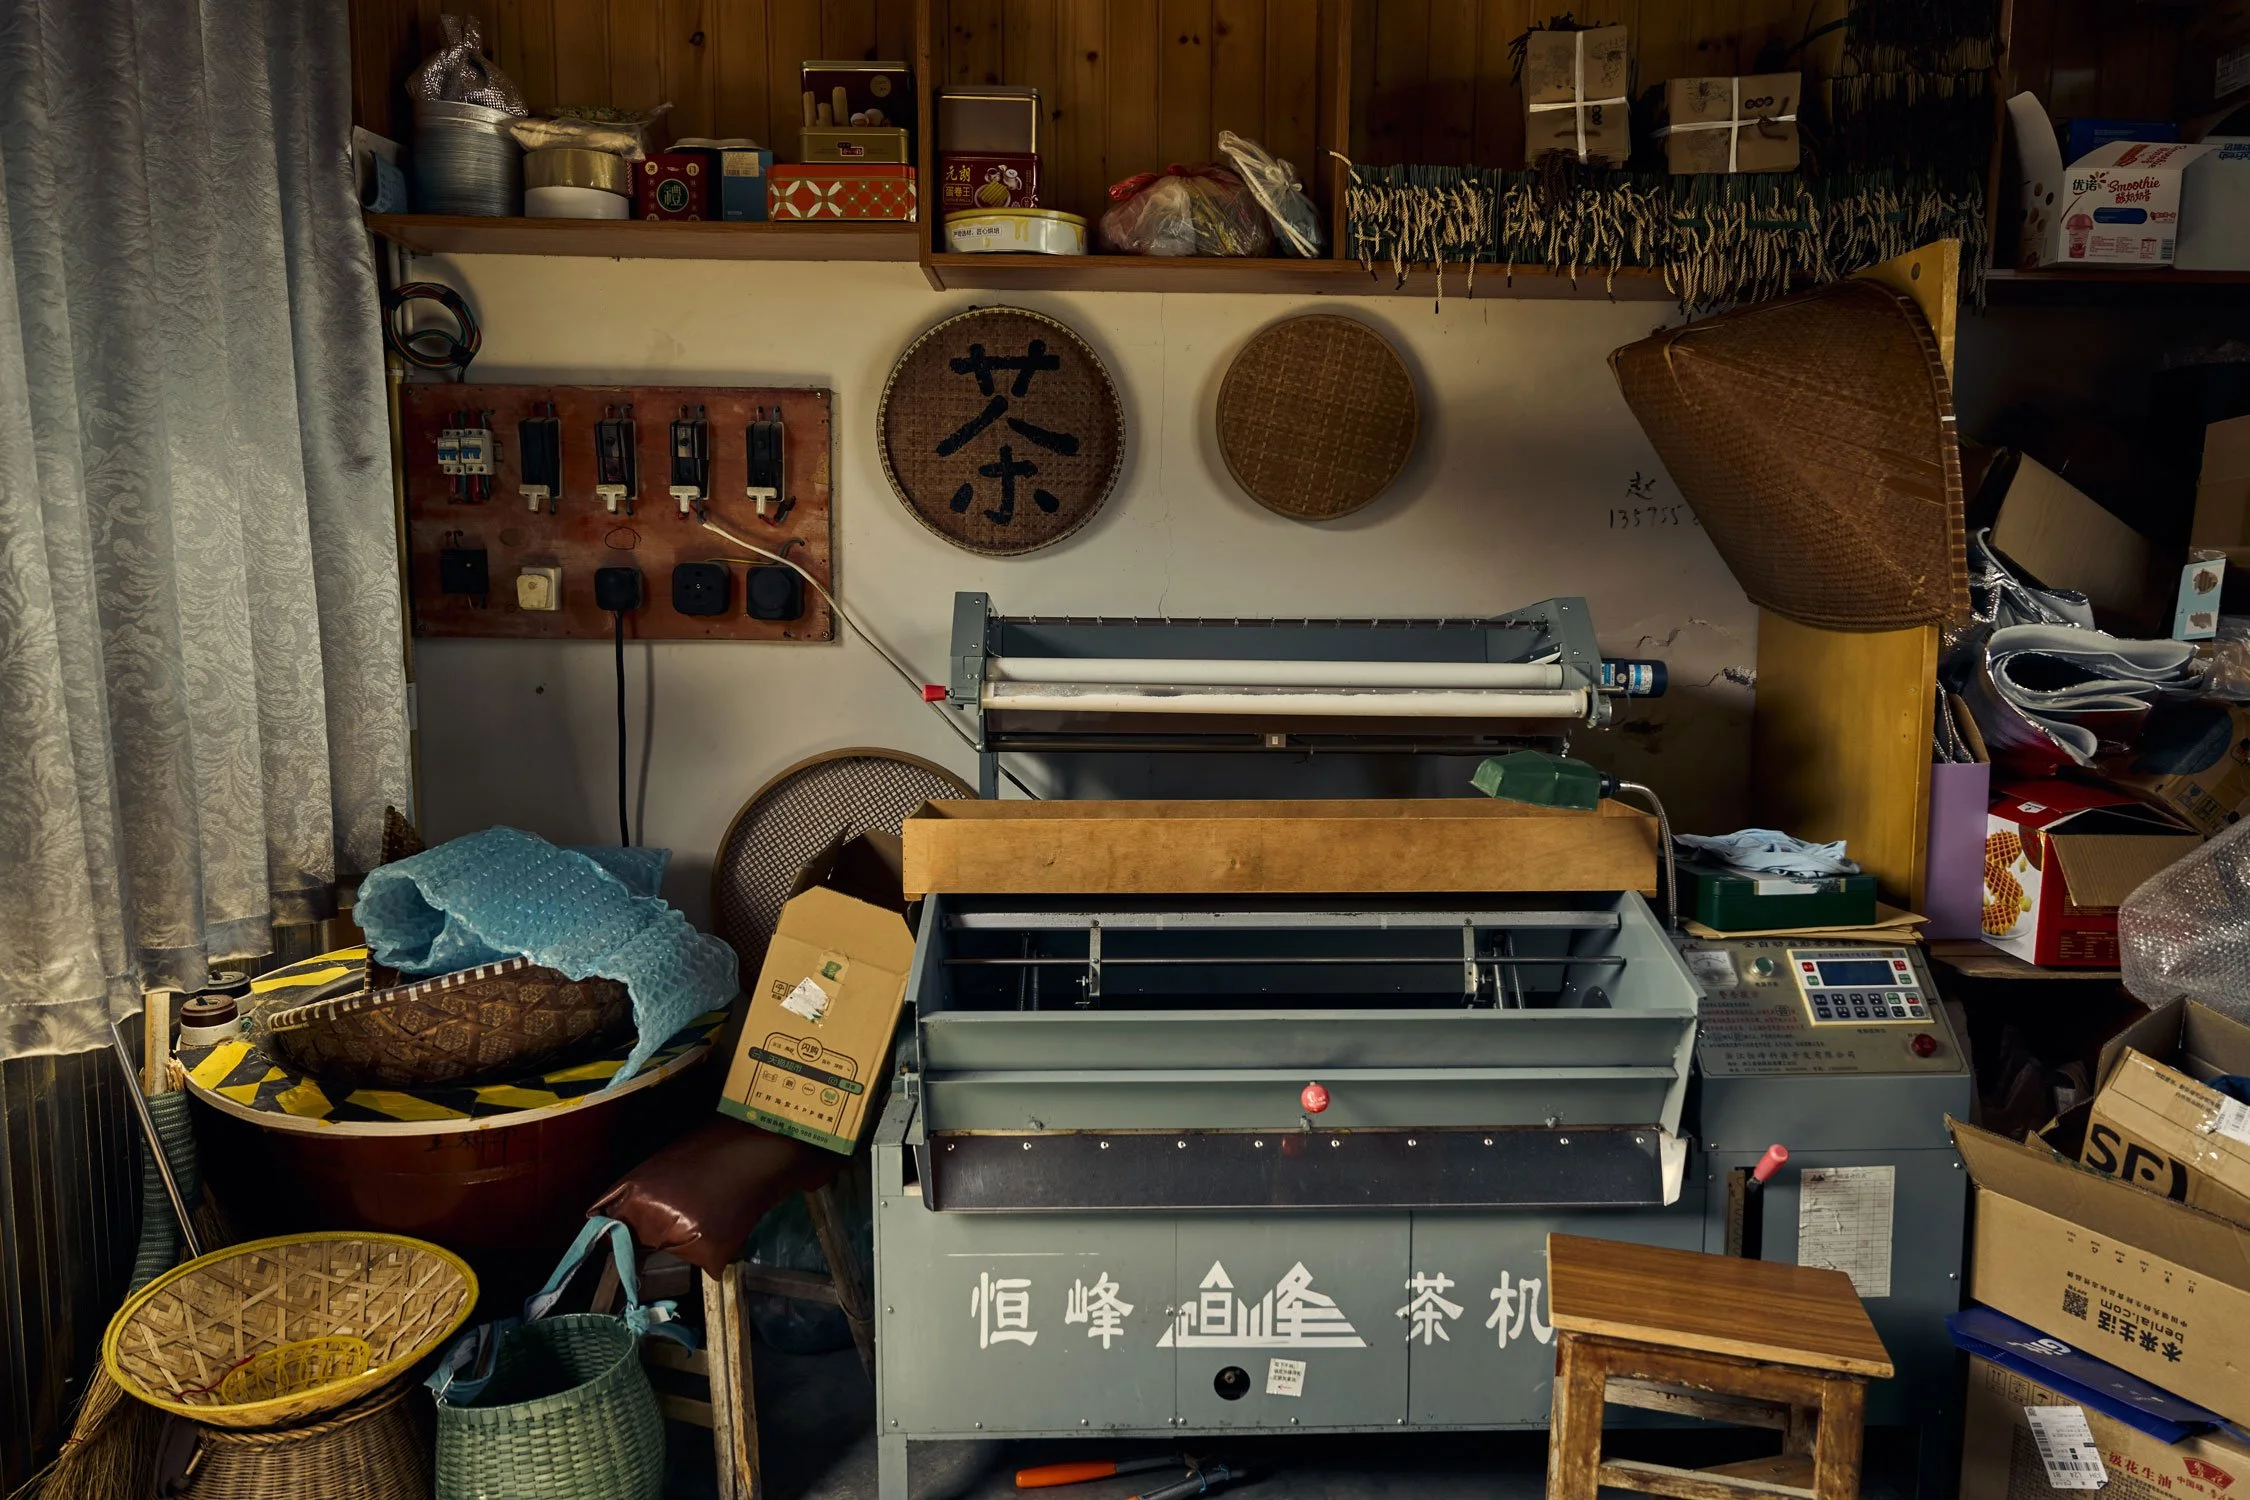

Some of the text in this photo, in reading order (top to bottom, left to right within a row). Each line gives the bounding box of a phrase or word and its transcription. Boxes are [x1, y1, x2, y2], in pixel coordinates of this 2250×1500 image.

[945, 165, 971, 182] 元朗
[945, 186, 971, 197] 蛋卷王
[2073, 179, 2097, 191] 优诺
[2108, 176, 2161, 193] Smoothie
[2115, 189, 2151, 204] 酸奶奶昔
[936, 339, 1079, 526] 茶
[801, 1042, 819, 1055] 闪购
[767, 1056, 802, 1072] 天猫超市
[971, 1271, 1134, 1349] 恒峰
[1396, 1270, 1554, 1349] 茶机
[2100, 1299, 2183, 1344] benlai.com
[2098, 1310, 2182, 1362] 本来生活
